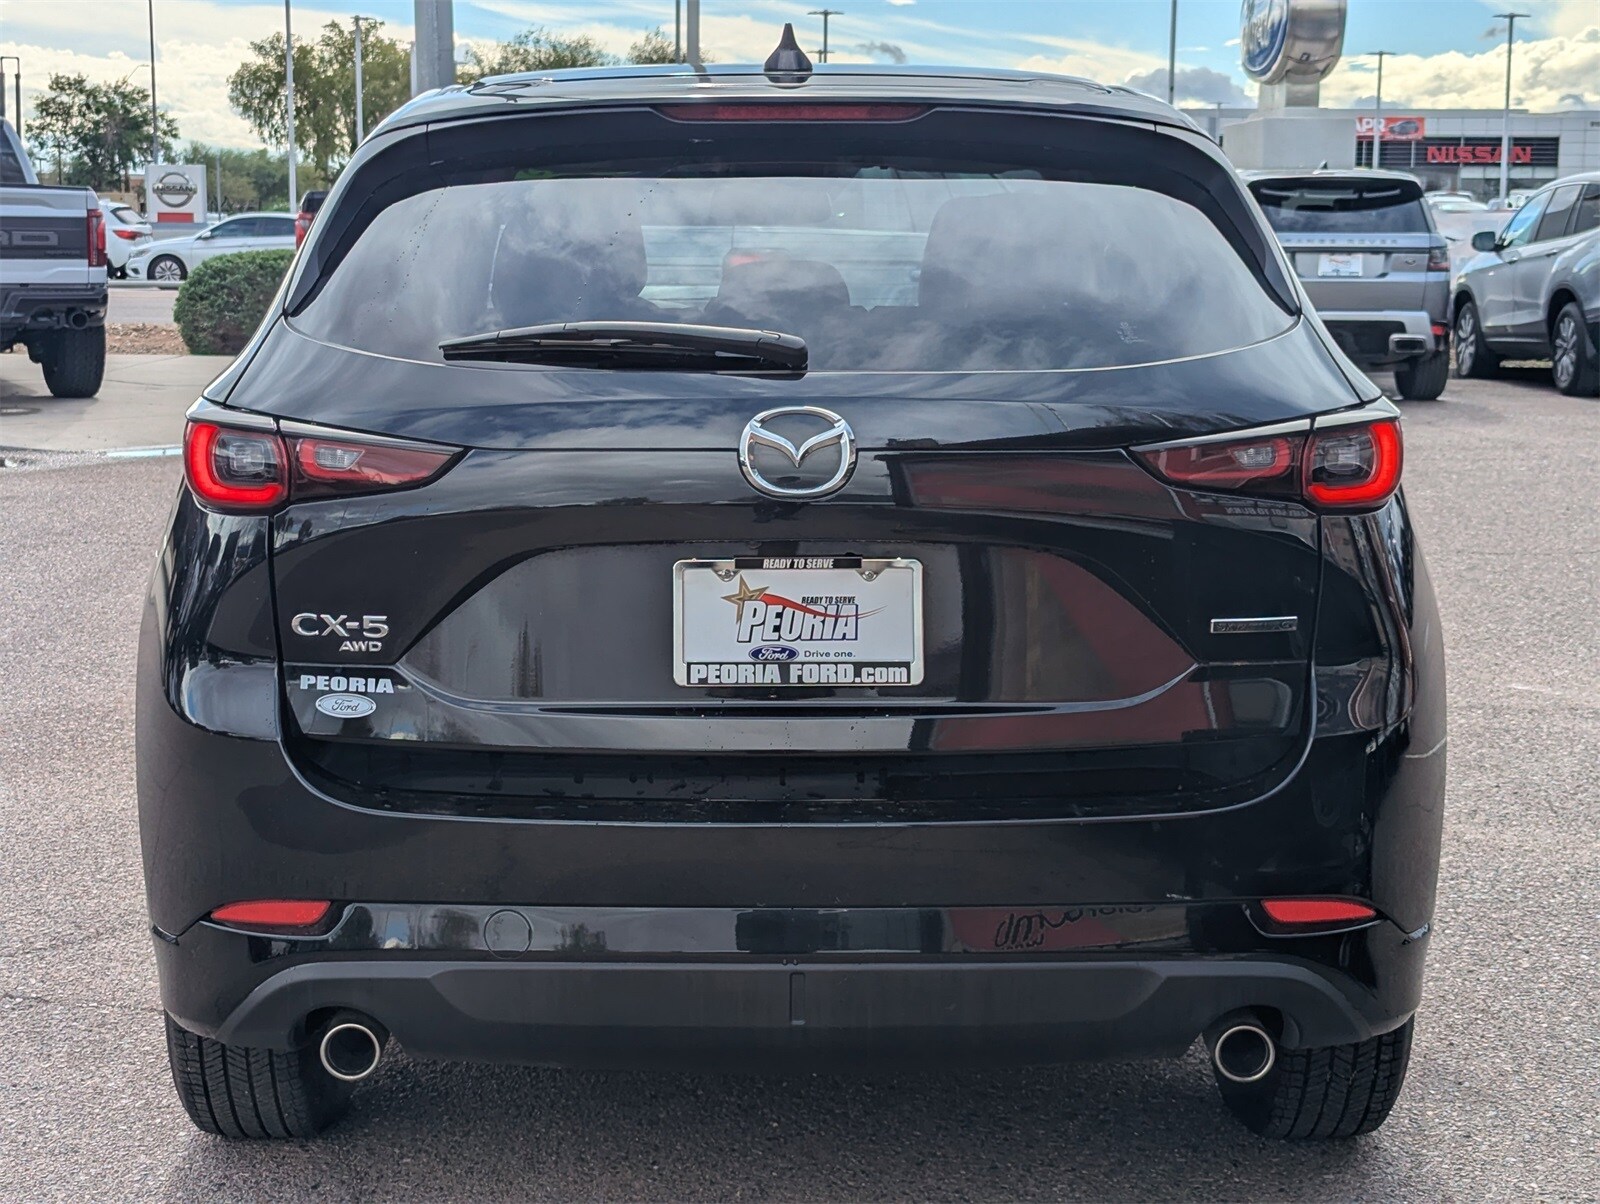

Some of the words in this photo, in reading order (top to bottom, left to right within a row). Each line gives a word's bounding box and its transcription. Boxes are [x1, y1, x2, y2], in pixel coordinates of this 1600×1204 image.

[1427, 146, 1532, 163] NISSAN
[154, 184, 193, 192] NISSAN
[762, 558, 792, 569] READY
[793, 558, 805, 569] TO
[806, 558, 834, 569] SERVE
[801, 596, 823, 604] READY
[824, 596, 833, 604] TO
[835, 596, 856, 604] SERVE
[291, 612, 390, 639] CX-5
[736, 599, 859, 643] PEORIA
[338, 641, 383, 652] AWD
[758, 647, 789, 660] Ford
[804, 650, 830, 658] Drive
[690, 664, 781, 684] PEORIA
[789, 664, 908, 684] FORD.com
[299, 674, 395, 694] PEORIA
[331, 699, 360, 712] Ford
